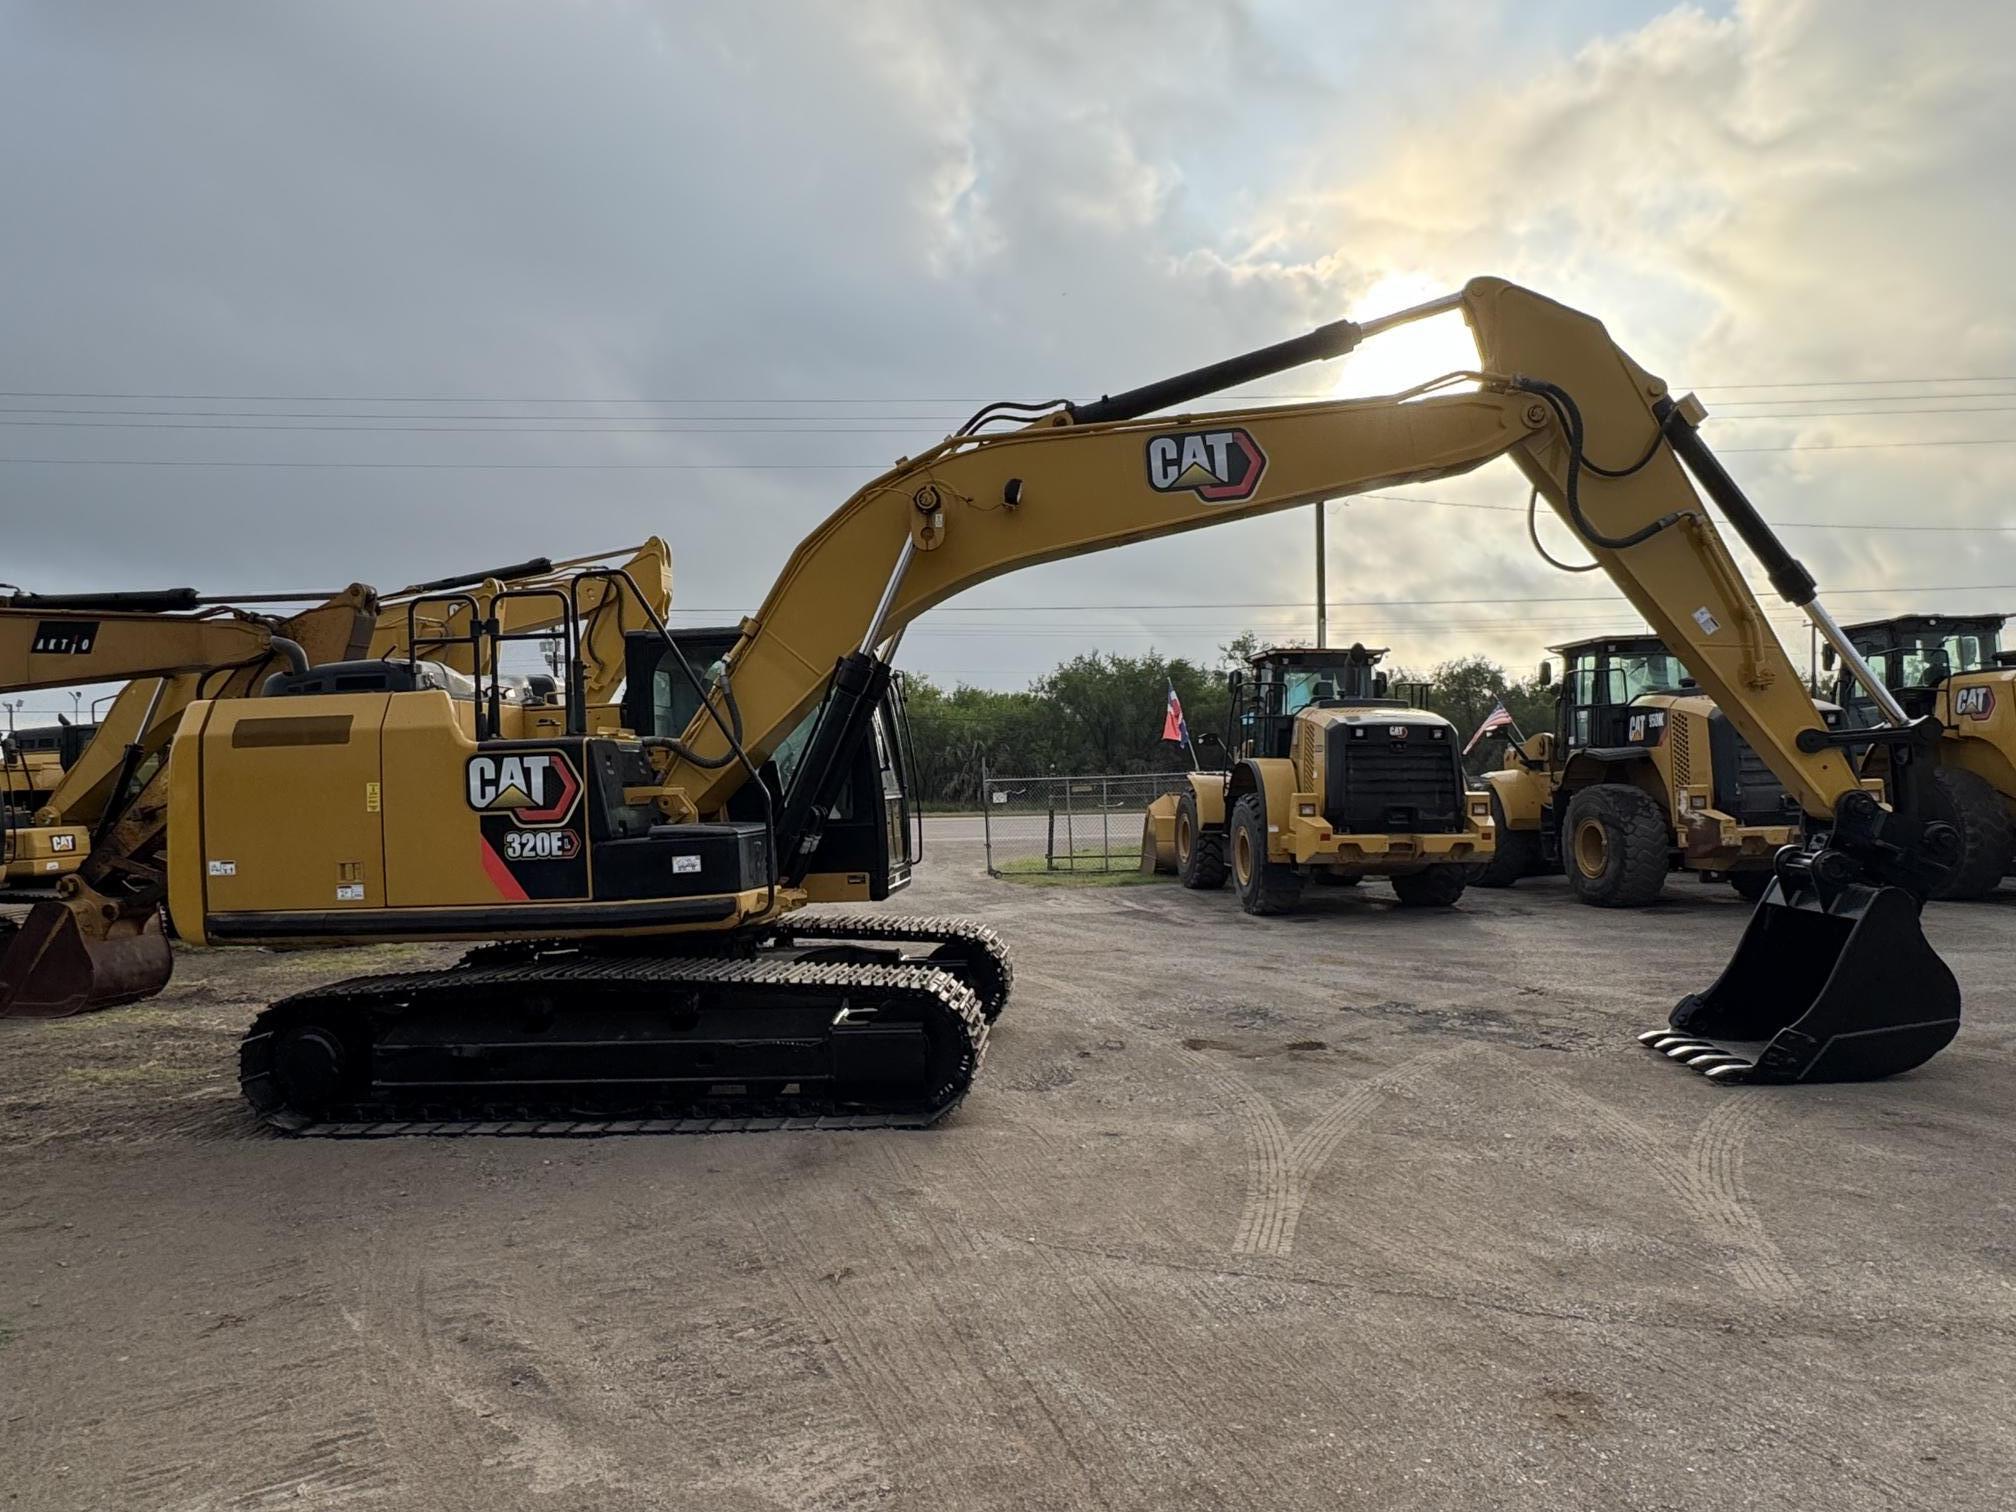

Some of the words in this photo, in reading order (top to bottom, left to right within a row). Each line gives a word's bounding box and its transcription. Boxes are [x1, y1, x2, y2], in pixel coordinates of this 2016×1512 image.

[1150, 432, 1234, 489] CAT
[1956, 687, 1987, 714] CAT
[1629, 714, 1646, 742] CAT
[469, 756, 550, 808] CAT
[52, 836, 74, 852] CAT
[506, 832, 563, 858] 320E
